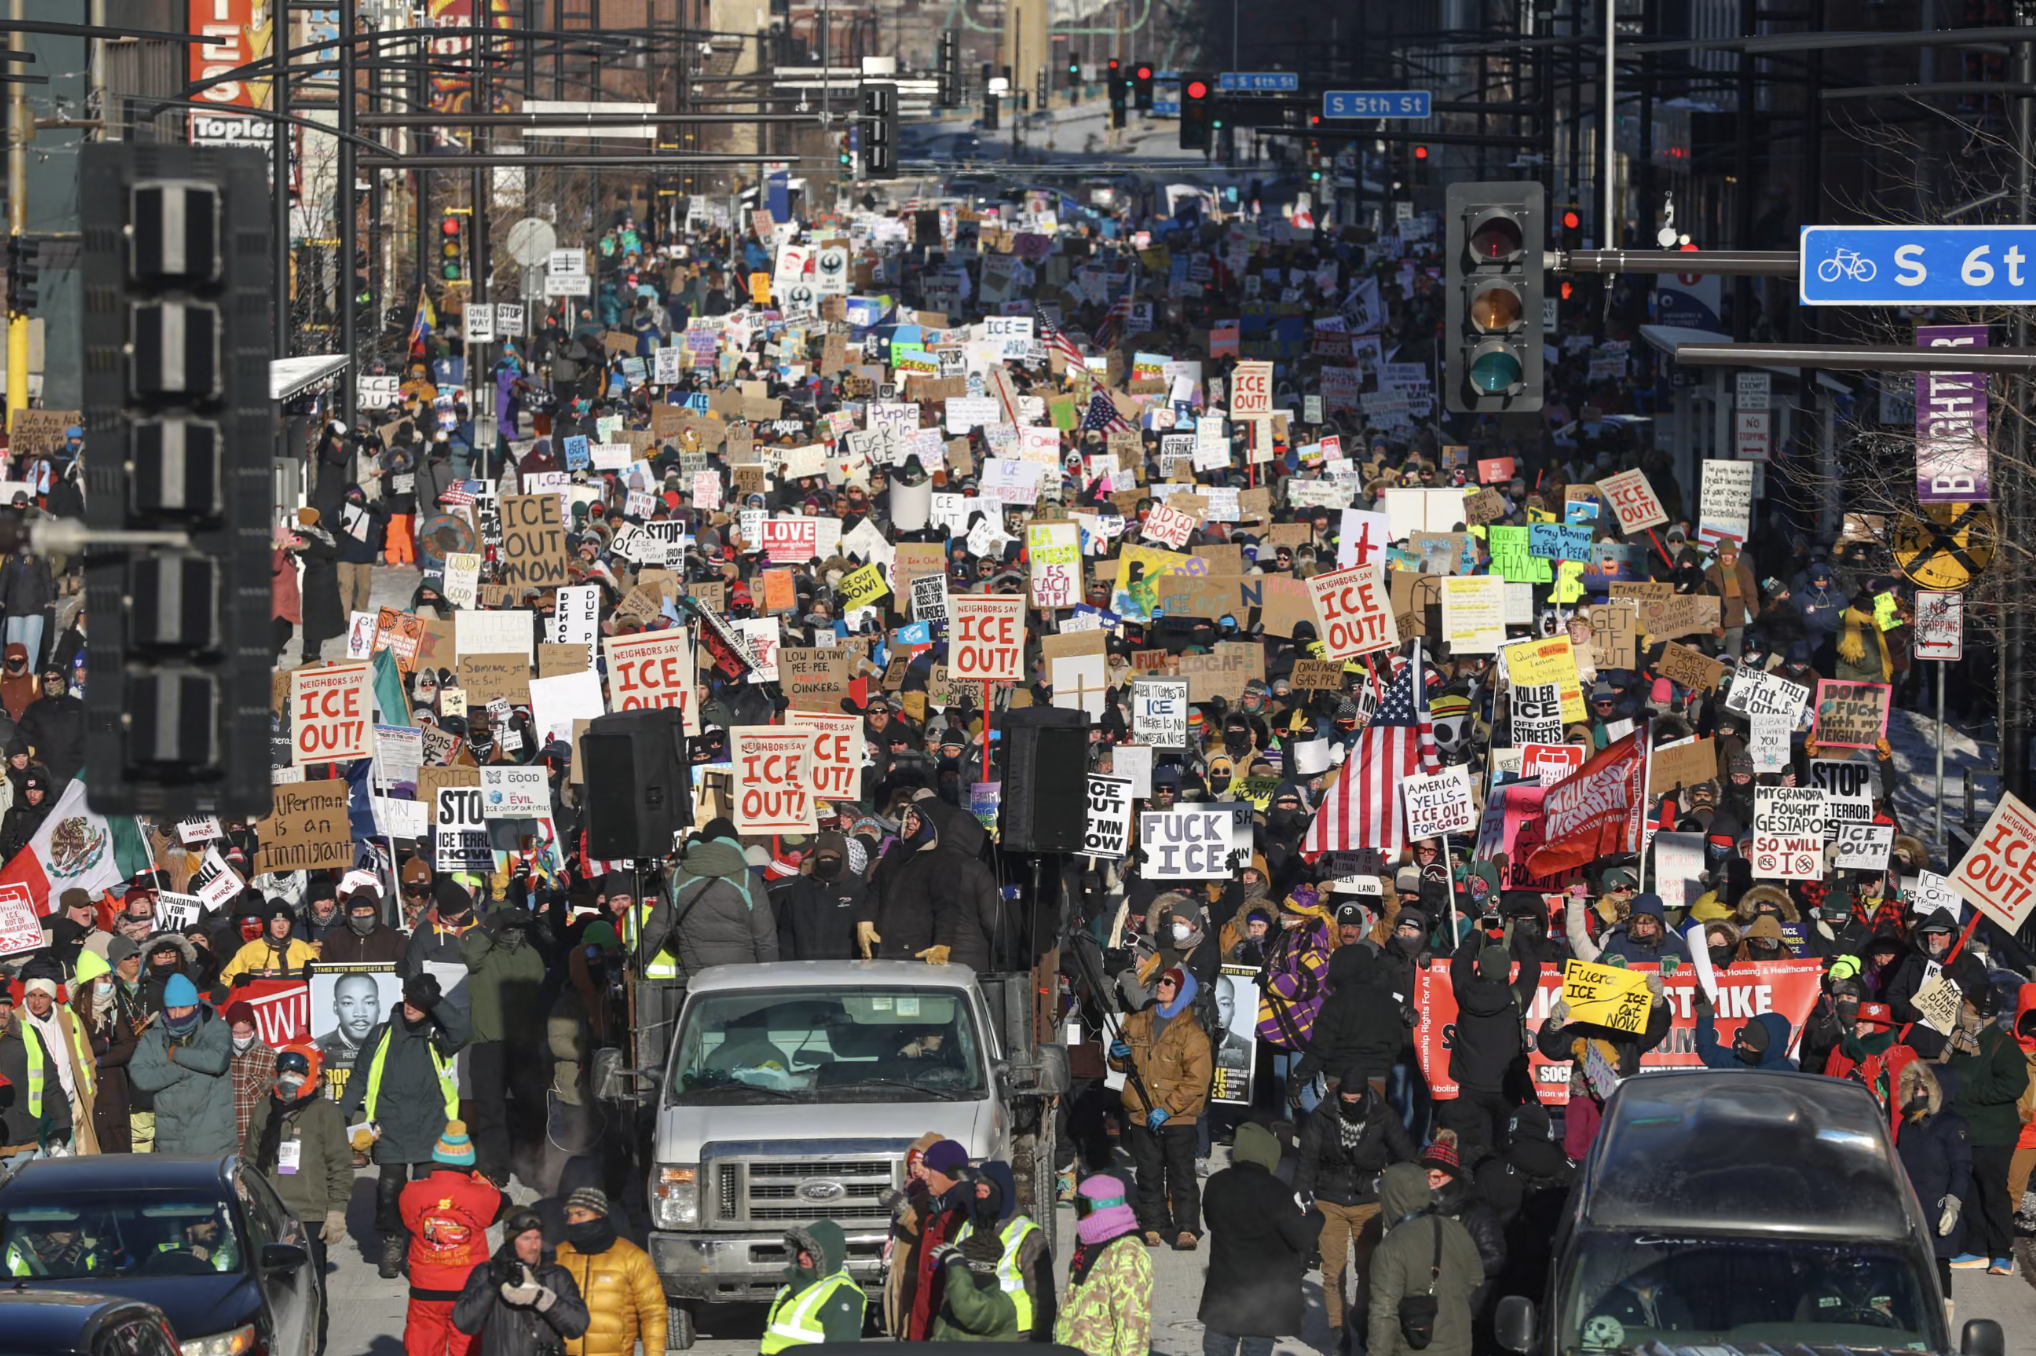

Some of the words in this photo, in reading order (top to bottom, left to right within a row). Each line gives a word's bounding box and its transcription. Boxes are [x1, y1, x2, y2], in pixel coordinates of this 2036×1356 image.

[1332, 98, 1344, 112] S
[1355, 97, 1390, 112] 5th
[1401, 97, 1422, 112] St
[1894, 244, 1927, 286] S
[469, 308, 489, 317] ONE
[498, 306, 522, 319] STOP
[470, 318, 491, 327] WAY
[986, 321, 1011, 334] ICE
[1235, 377, 1265, 392] ICE
[1235, 394, 1268, 411] OUT!
[871, 403, 918, 422] Purple
[1746, 419, 1760, 428] NO
[852, 429, 898, 451] FUCK
[1739, 432, 1767, 441] STOPPING
[569, 446, 586, 454] OUT
[1164, 443, 1194, 455] STRIKE
[1611, 484, 1648, 507] ICE
[504, 496, 560, 528] ICE
[1151, 503, 1173, 522] JD
[1174, 514, 1192, 532] GO
[1620, 502, 1657, 523] OUT!
[646, 522, 684, 543] STOP
[763, 522, 815, 541] LOVE
[1144, 522, 1187, 547] HOME
[1560, 524, 1592, 542] Bovino
[505, 530, 561, 558] OUT
[1490, 542, 1510, 555] ICE
[1529, 544, 1562, 558] TEENY
[509, 555, 565, 585] NOW
[1047, 565, 1065, 578] ES
[1491, 554, 1550, 580] SHAME
[854, 569, 872, 586] OUT
[1032, 576, 1070, 592] CACA
[1316, 575, 1357, 593] NEIGHBORS
[1359, 572, 1374, 583] SAY
[485, 587, 502, 603] ICE
[695, 585, 718, 597] ICE
[914, 582, 944, 596] JONATHAN
[1613, 585, 1645, 595] TIME
[957, 605, 1002, 614] NEIGHBORS
[1004, 605, 1019, 614] SAY
[1320, 583, 1380, 621] ICE
[1930, 602, 1948, 613] NO
[916, 604, 946, 620] MURDER
[1592, 607, 1632, 630] GET
[957, 615, 1016, 644] ICE
[1328, 613, 1387, 651] OUT!
[1648, 616, 1695, 636] NEIGHBORS
[1920, 620, 1958, 633] STOPPING
[614, 646, 662, 662] NEIGHBORS
[664, 644, 681, 655] SAY
[785, 650, 807, 662] LOW
[957, 646, 1019, 676] OUT!
[1136, 652, 1166, 669] FUCK
[464, 657, 508, 674] Someone
[1298, 662, 1319, 675] ONLY
[1675, 660, 1706, 676] OVER
[616, 656, 682, 692] ICE
[1295, 674, 1318, 687] GAS
[1664, 665, 1709, 689] EMPIRE
[1737, 666, 1768, 683] Suck
[300, 675, 341, 691] NEIGHBORS
[342, 674, 365, 686] SAY
[947, 683, 979, 698] SNIFFS
[1515, 685, 1554, 703] KILLER
[1749, 681, 1777, 705] fat
[1779, 681, 1806, 703] my
[299, 687, 361, 721] ICE
[1146, 699, 1175, 715] ICE
[1513, 701, 1560, 718] ICE
[840, 723, 855, 732] SAY
[1136, 715, 1161, 730] THERE
[1513, 719, 1536, 729] OFF
[1537, 719, 1561, 729] OUR
[1860, 718, 1883, 731] my
[299, 720, 364, 753] OUT!
[1513, 726, 1562, 744] STREETS
[1760, 736, 1778, 745] YOU
[741, 741, 790, 753] NEIGHBORS
[790, 741, 807, 751] SAY
[742, 754, 802, 785] ICE
[508, 773, 540, 783] GOOD
[1235, 781, 1252, 790] ICE
[1254, 780, 1277, 789] OUT
[1407, 775, 1462, 796] AMERICA
[1811, 763, 1869, 797] STOP
[510, 795, 534, 804] EVIL
[1233, 788, 1274, 801] NOW!
[1757, 788, 1776, 800] MY
[1777, 788, 1824, 801] GRANDPA
[532, 804, 551, 812] CITIES
[741, 789, 806, 820] OUT!
[1411, 807, 1438, 823] ICE
[1442, 800, 1467, 817] OUT
[1771, 801, 1820, 817] FOUGHT
[1830, 803, 1870, 820] TERROR
[275, 820, 286, 837] is
[305, 820, 331, 834] an
[1096, 820, 1123, 836] MN
[1142, 812, 1223, 844] FUCK
[1413, 819, 1438, 836] FOR
[1436, 814, 1470, 831] GOOD
[1756, 815, 1824, 834] GESTAPO
[438, 832, 456, 848] ICE
[1842, 827, 1878, 841] ICE
[1757, 838, 1779, 852] SO
[1785, 837, 1821, 852] WILL
[1840, 842, 1888, 856] OUT!
[262, 841, 352, 869] Immigrant
[1157, 844, 1225, 875] ICE
[1983, 822, 2036, 886] ICE
[1780, 852, 1794, 874] I
[198, 861, 222, 887] ALL
[1332, 873, 1355, 884] STOLEN
[1920, 871, 1945, 891] ICE
[1357, 884, 1376, 893] LAND
[1965, 853, 2034, 914] OUT!
[1926, 889, 1956, 903] OUT!
[170, 905, 185, 916] FOR
[5, 918, 16, 926] OUT
[313, 965, 332, 974] STAND
[333, 965, 349, 973] WITH
[349, 964, 382, 974] MINNESOTA
[1432, 965, 1447, 974] ICE
[1566, 963, 1619, 986] Fuera
[1727, 967, 1761, 978] Housing
[1770, 964, 1815, 975] Healthcare
[1422, 976, 1431, 988] All
[1940, 979, 1963, 1000] THAT
[1422, 991, 1431, 1007] For
[1566, 984, 1597, 1000] ICE
[1623, 992, 1649, 1006] ICE
[1936, 988, 1957, 1011] FINE
[1619, 1004, 1642, 1019] Out
[1928, 993, 1954, 1020] DUDE
[1421, 1006, 1431, 1032] Rights
[1605, 1012, 1642, 1032] NOW
[808, 1165, 831, 1177] Ford
